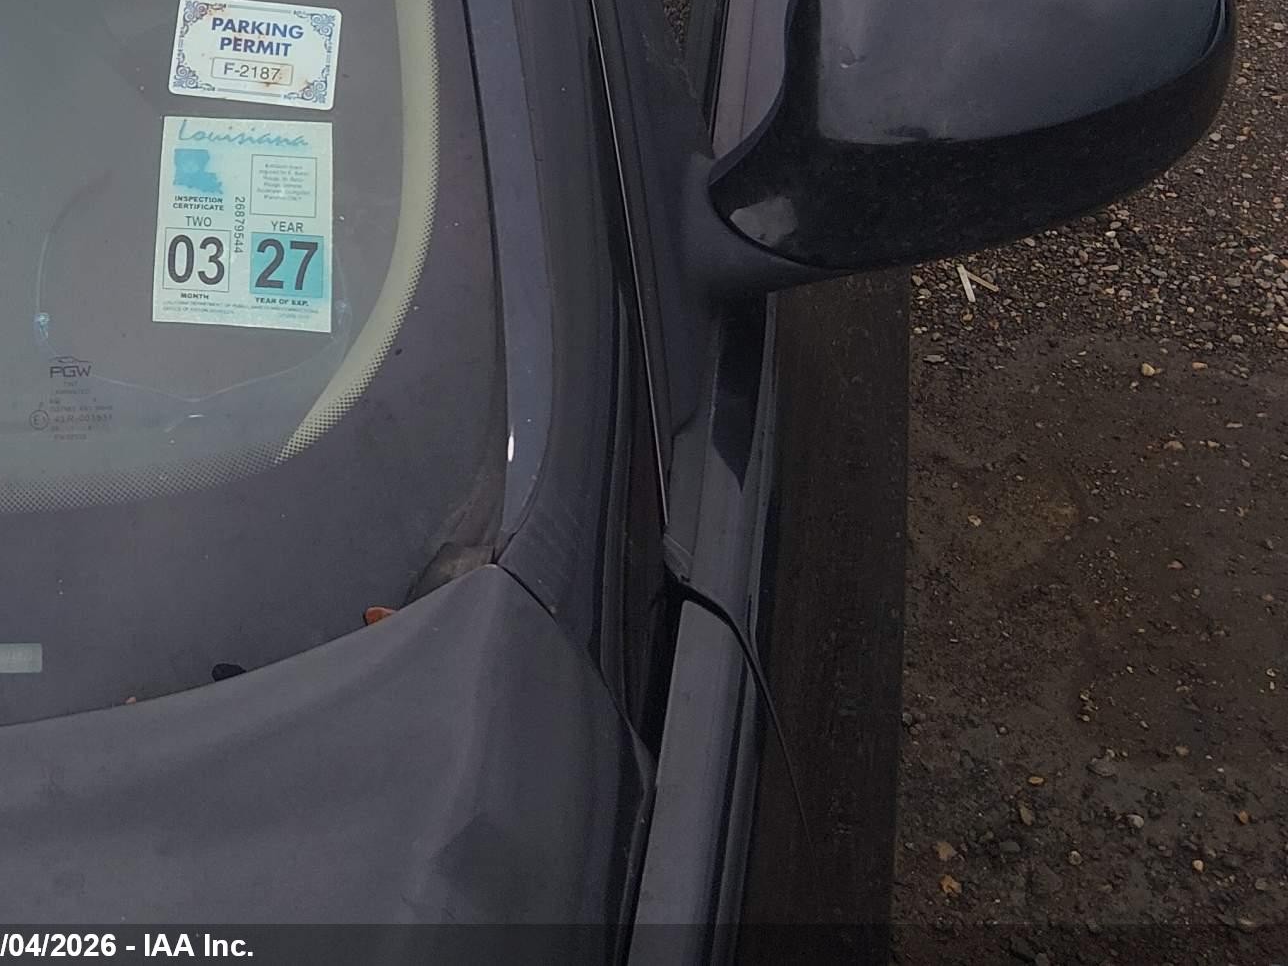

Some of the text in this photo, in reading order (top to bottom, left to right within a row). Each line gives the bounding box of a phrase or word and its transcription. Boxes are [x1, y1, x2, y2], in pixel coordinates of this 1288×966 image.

[212, 17, 304, 39] PARKING
[220, 37, 292, 57] PERMIT
[223, 62, 281, 81] F-2187
[178, 119, 309, 147] Louisiana
[172, 202, 225, 212] CERTIFICATE
[174, 195, 224, 204] INSPECTION
[186, 215, 212, 228] TWO
[234, 196, 246, 254] 26879544
[271, 221, 304, 233] YEAR
[168, 234, 225, 286] 03
[255, 238, 319, 291] 27
[255, 297, 278, 305] YEAR
[50, 365, 92, 378] PGW
